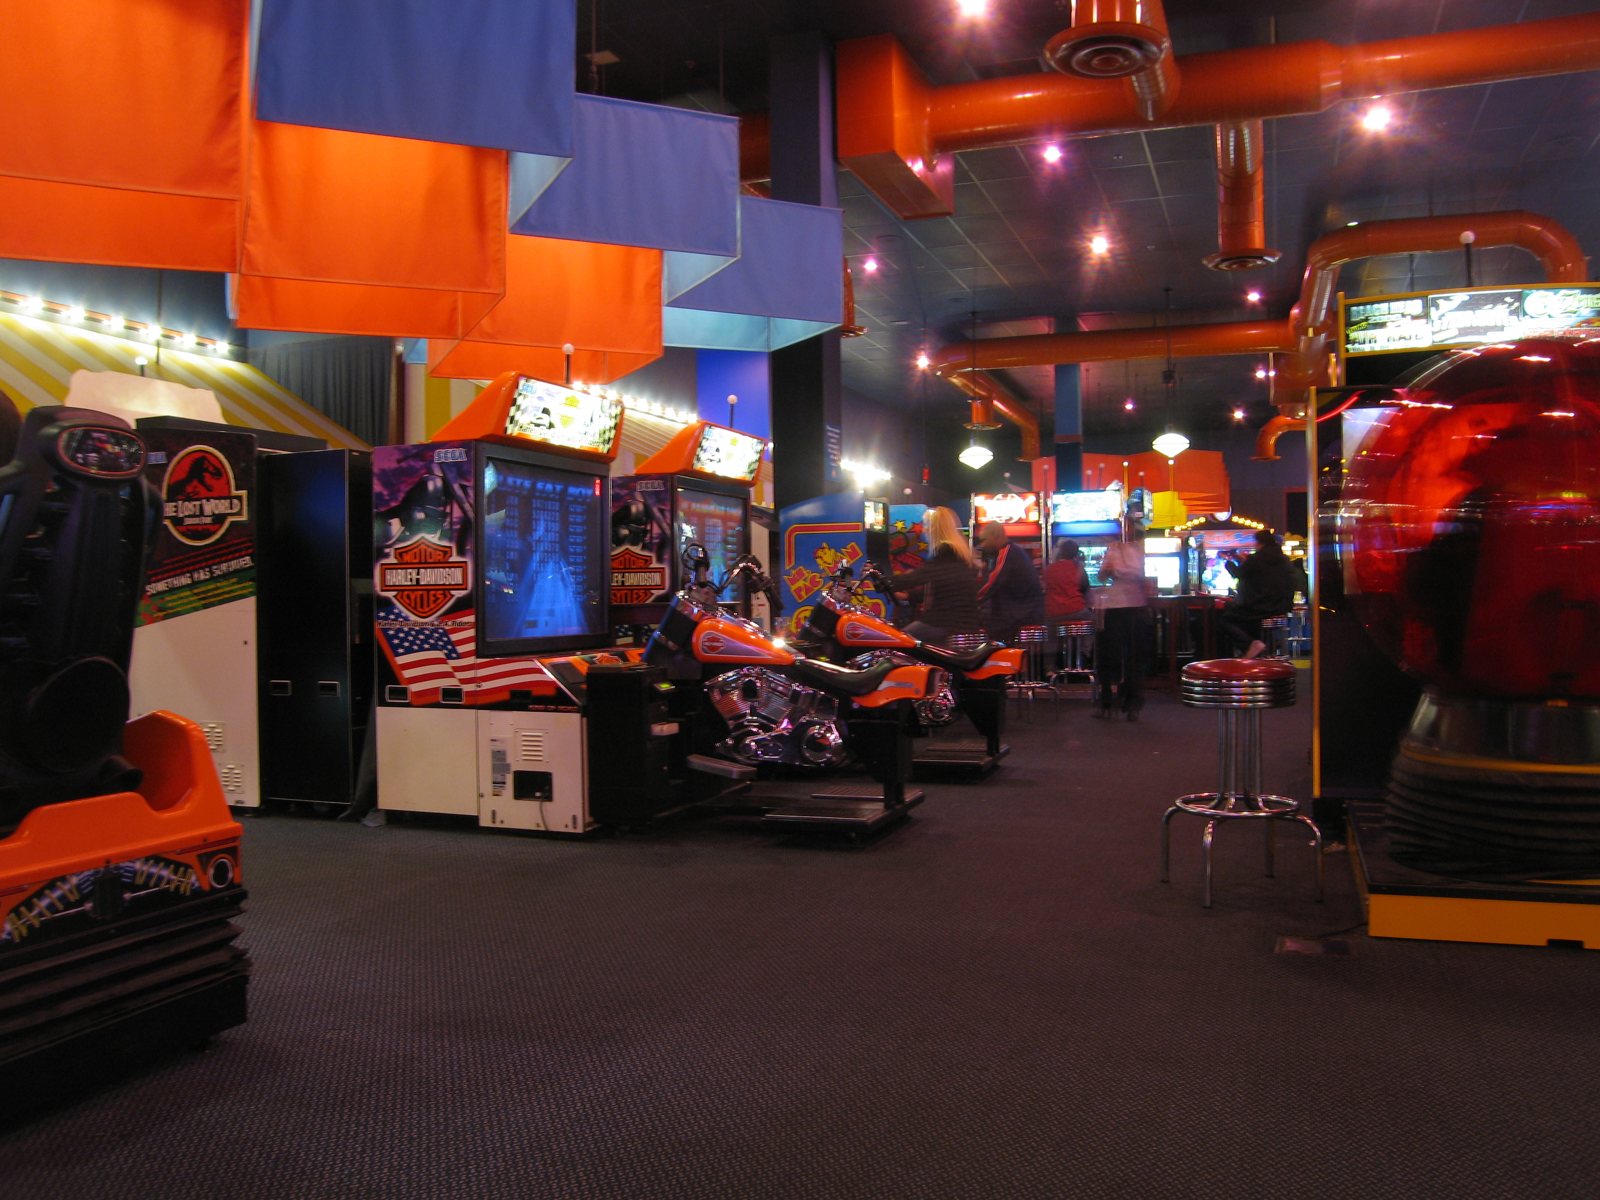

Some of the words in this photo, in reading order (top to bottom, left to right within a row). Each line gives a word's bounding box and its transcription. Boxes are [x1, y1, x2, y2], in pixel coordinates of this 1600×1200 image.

[434, 448, 467, 462] SEGA
[636, 480, 664, 491] SEGA
[164, 503, 177, 517] HE
[177, 501, 201, 518] LOST
[201, 499, 240, 516] WORLD
[402, 546, 445, 561] MOTOR
[384, 567, 464, 586] HARLEY-DAVIDSON
[402, 590, 447, 609] CYCLES
